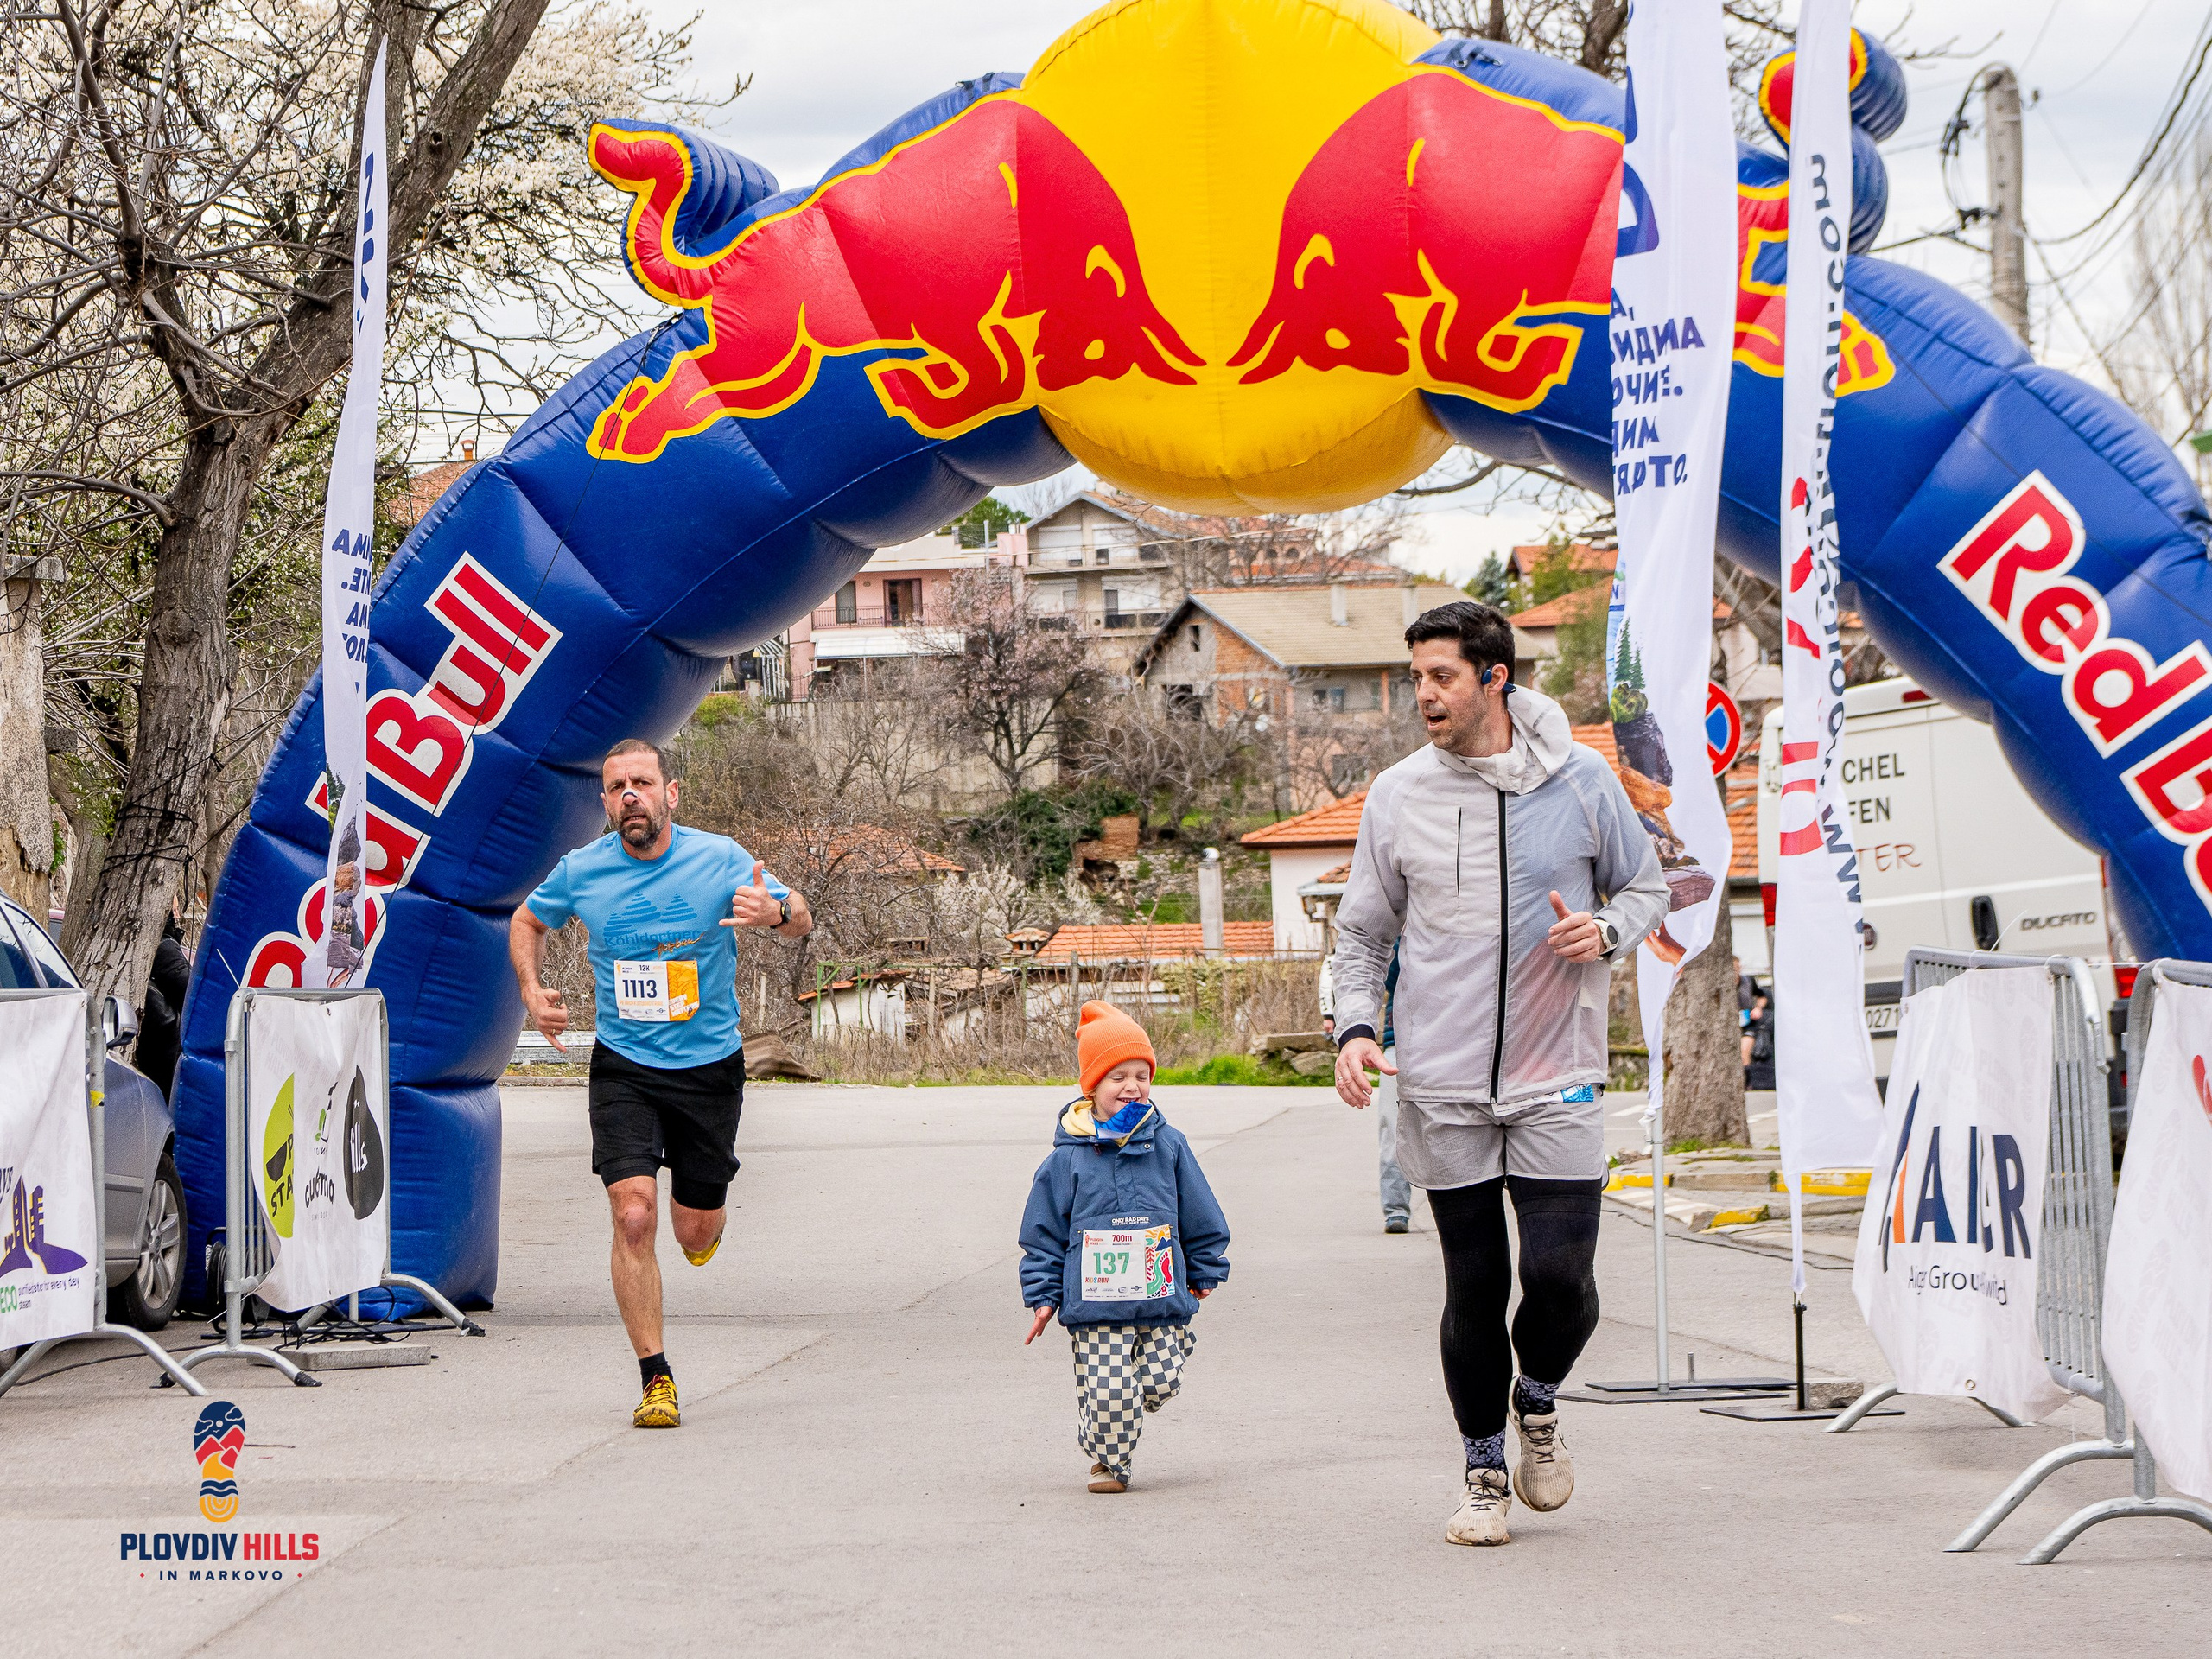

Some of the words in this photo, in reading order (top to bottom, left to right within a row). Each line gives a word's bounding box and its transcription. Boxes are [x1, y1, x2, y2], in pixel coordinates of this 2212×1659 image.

[1950, 485, 2209, 746] Red
[366, 563, 551, 807] Bull
[2019, 912, 2098, 931] DUCATO
[622, 979, 658, 999] 1113
[1111, 1234, 1133, 1243] 700m
[1093, 1252, 1130, 1274] 137
